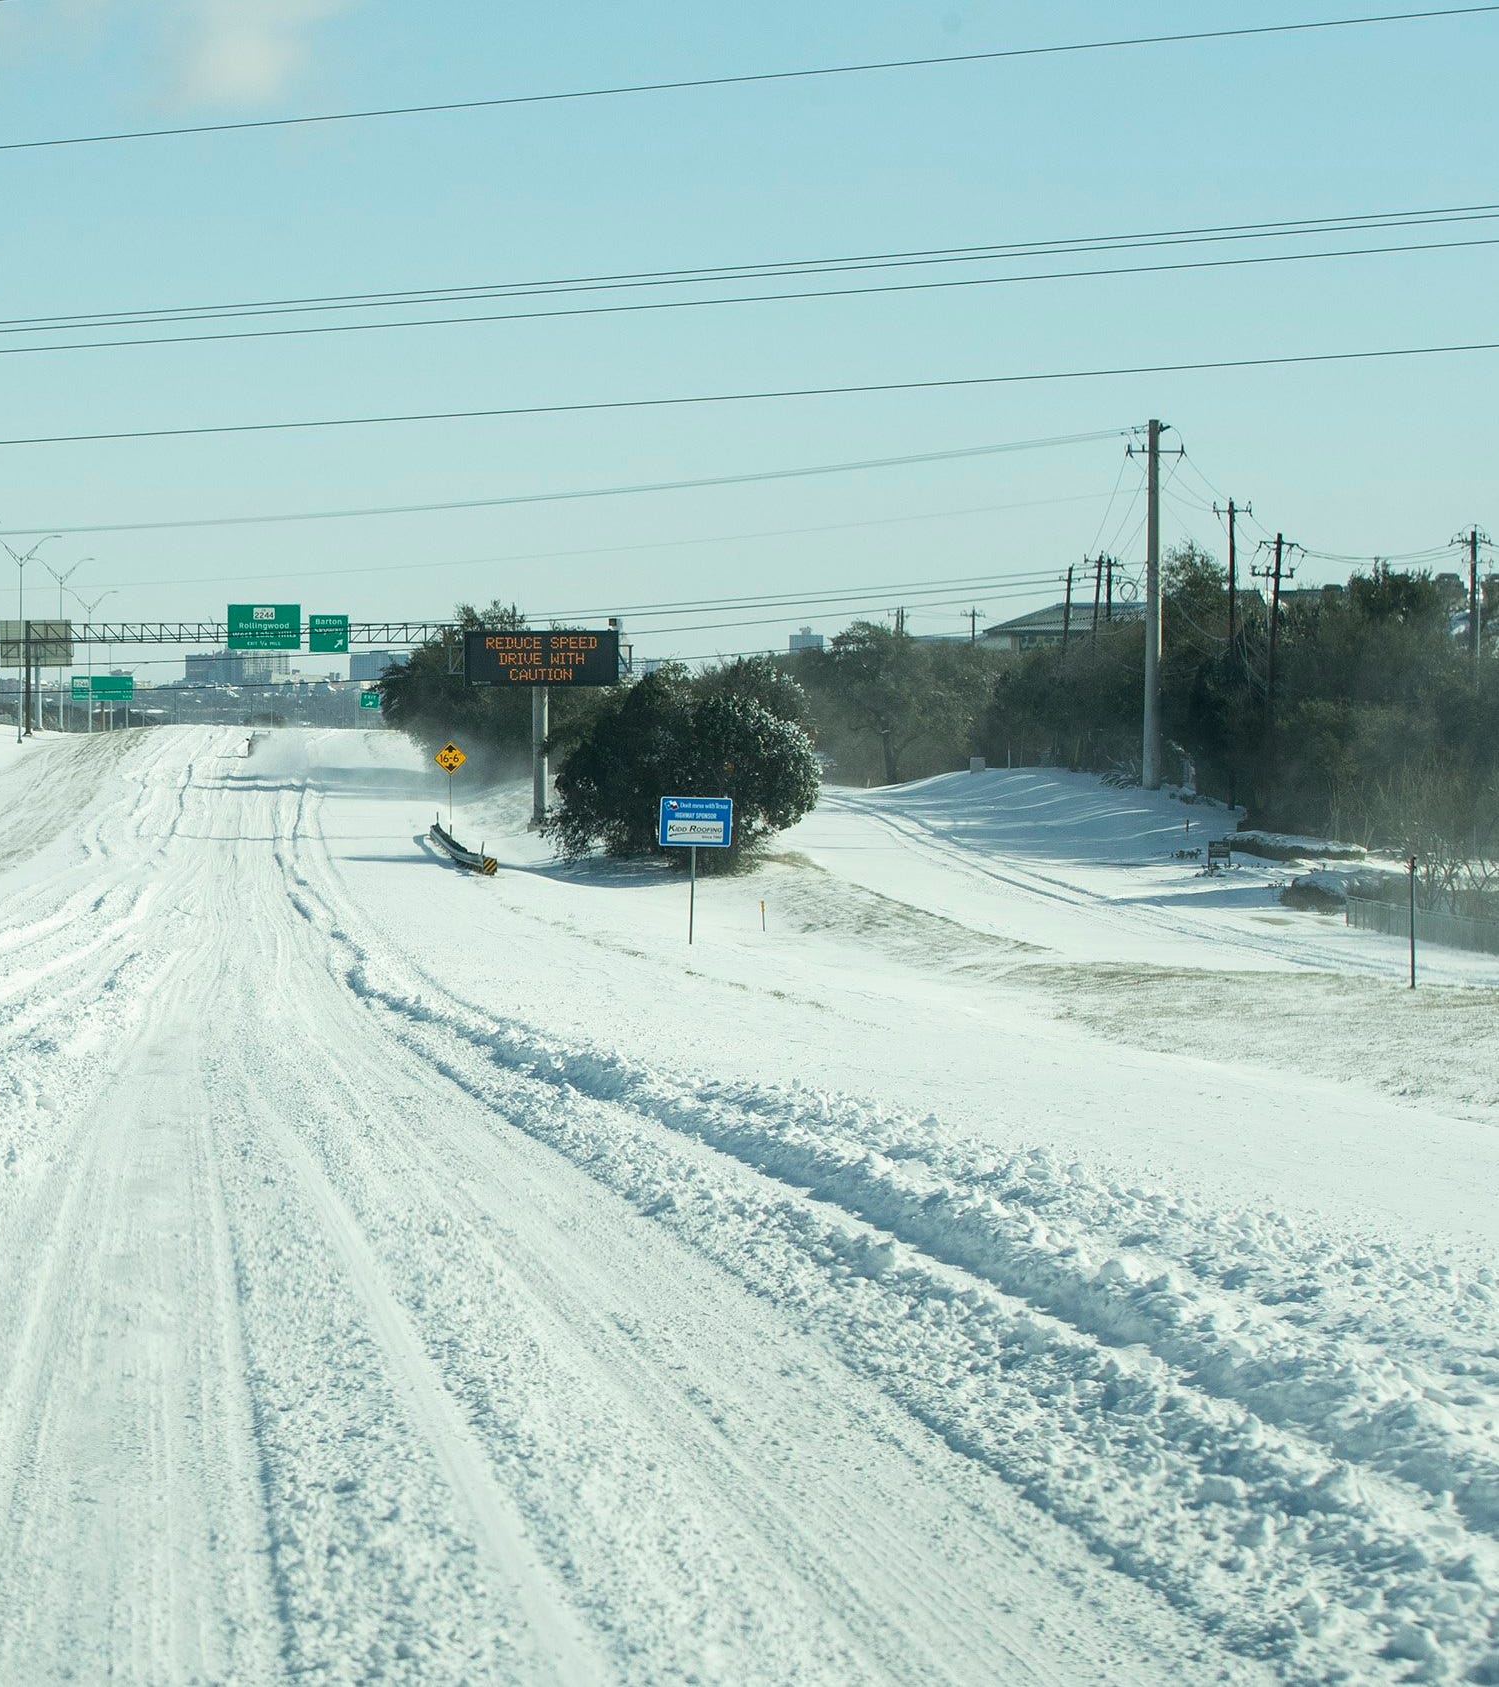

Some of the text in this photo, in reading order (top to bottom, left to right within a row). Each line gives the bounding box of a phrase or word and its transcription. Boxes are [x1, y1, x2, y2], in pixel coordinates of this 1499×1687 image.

[254, 611, 274, 619] 2244
[239, 622, 290, 631] Rollingwood
[485, 636, 598, 650] REDUCE SPEED
[498, 652, 586, 665] DRIVE WITH
[509, 668, 573, 681] CAUTION
[695, 812, 717, 820] SPONSOR
